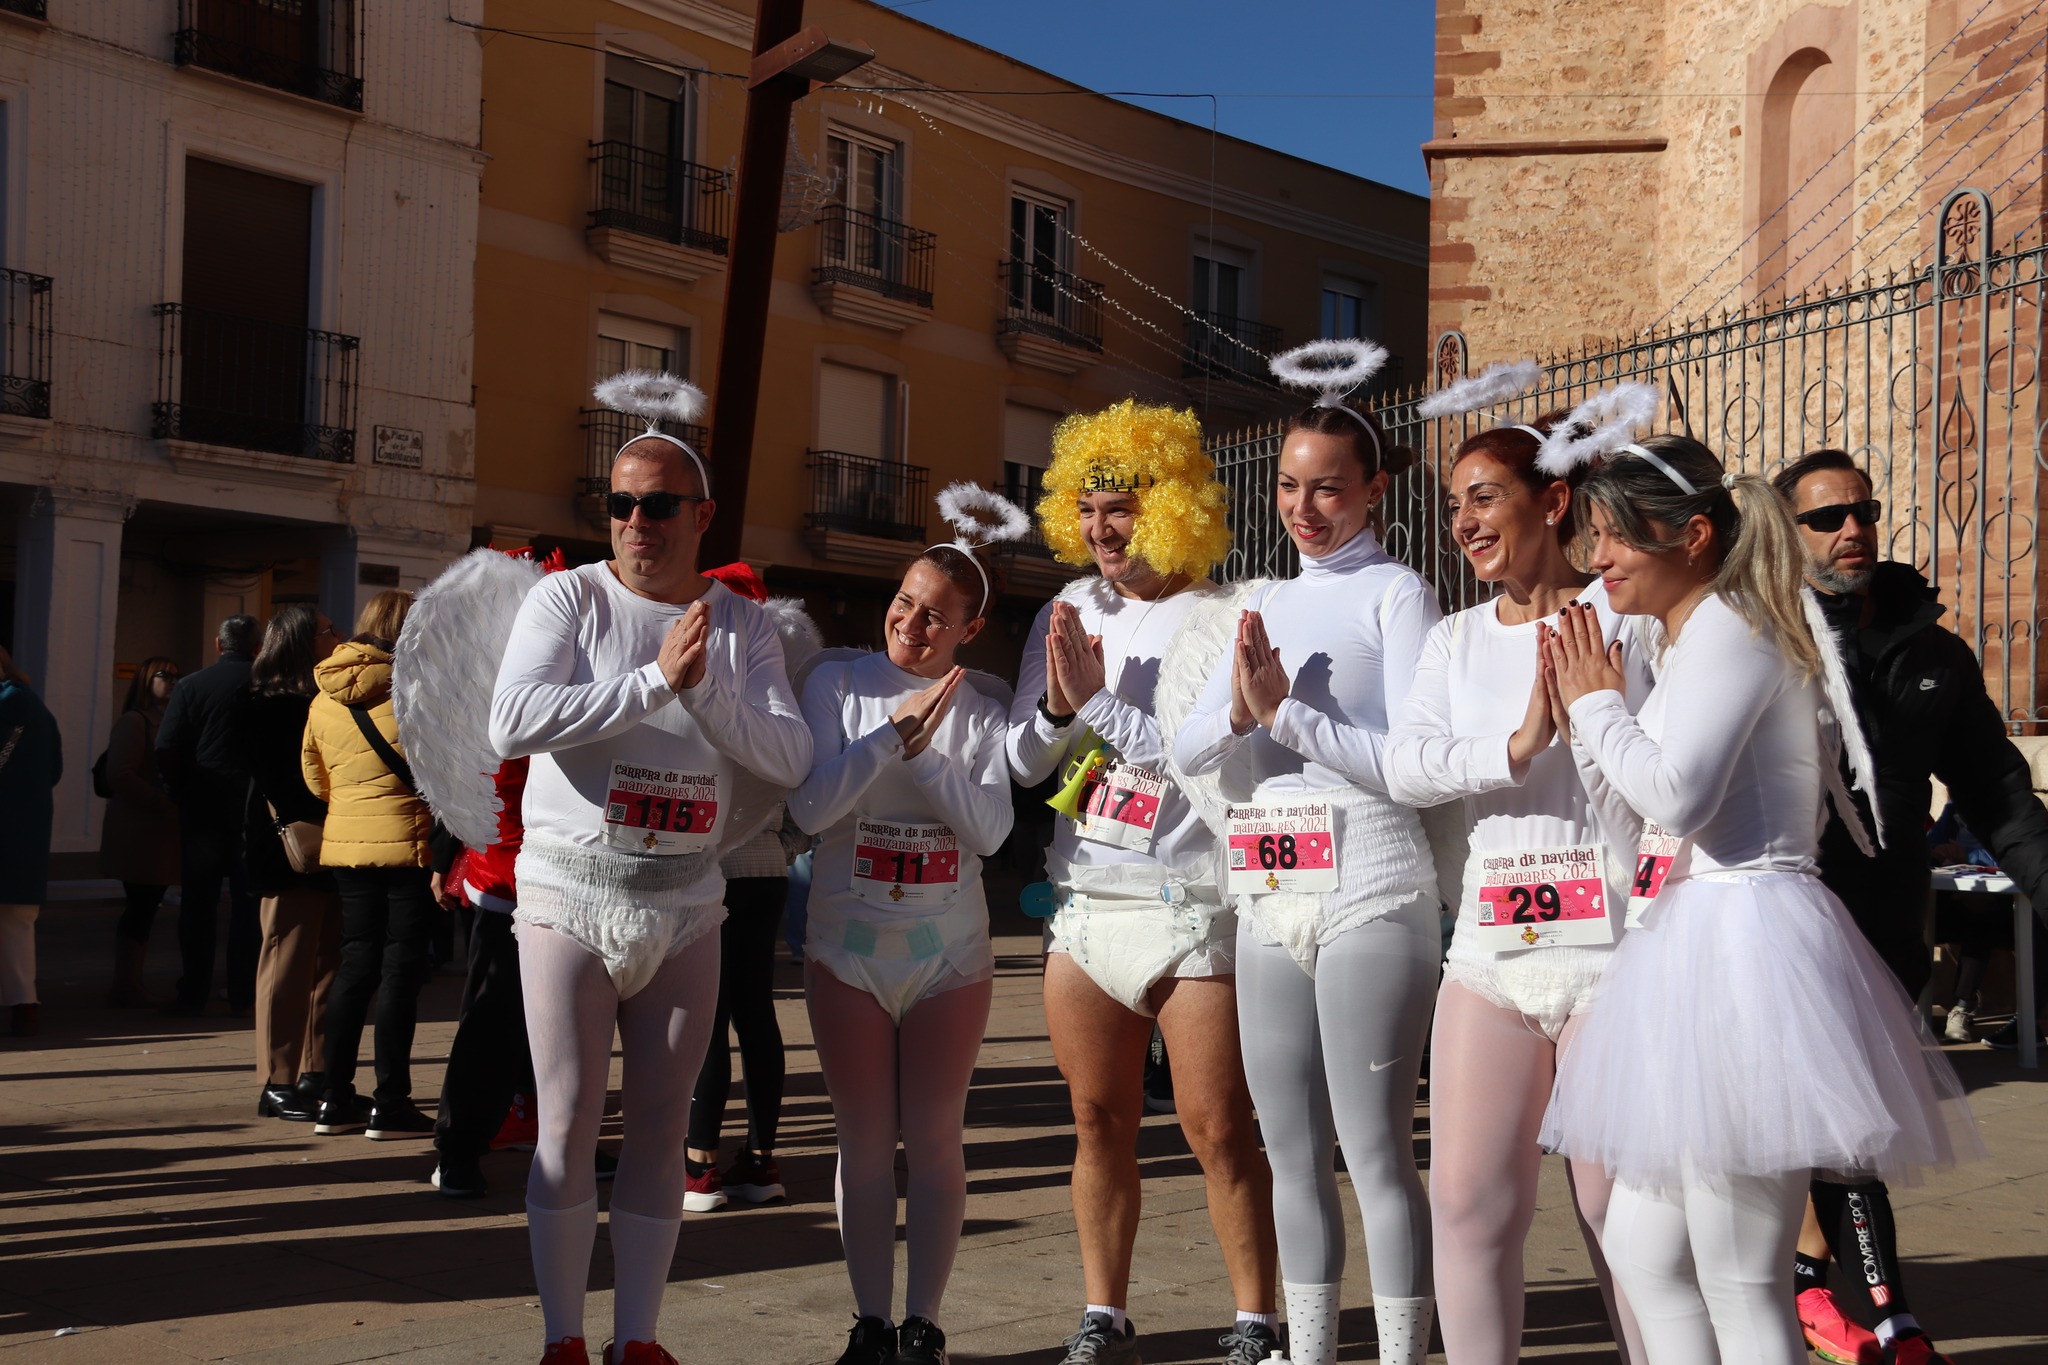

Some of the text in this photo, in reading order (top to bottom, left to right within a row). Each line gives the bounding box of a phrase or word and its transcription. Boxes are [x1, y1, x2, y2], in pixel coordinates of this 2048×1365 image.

[681, 774, 717, 787] navidad
[1131, 777, 1161, 797] 2024
[692, 785, 716, 801] 2024
[637, 795, 694, 833] 115
[1287, 803, 1328, 818] navidad
[1300, 816, 1327, 832] 2024
[934, 836, 957, 850] 2024
[1259, 834, 1298, 870] 68
[1541, 848, 1595, 866] navidad
[891, 852, 923, 884] 11
[1562, 862, 1597, 880] 2024
[1508, 884, 1561, 924] 29
